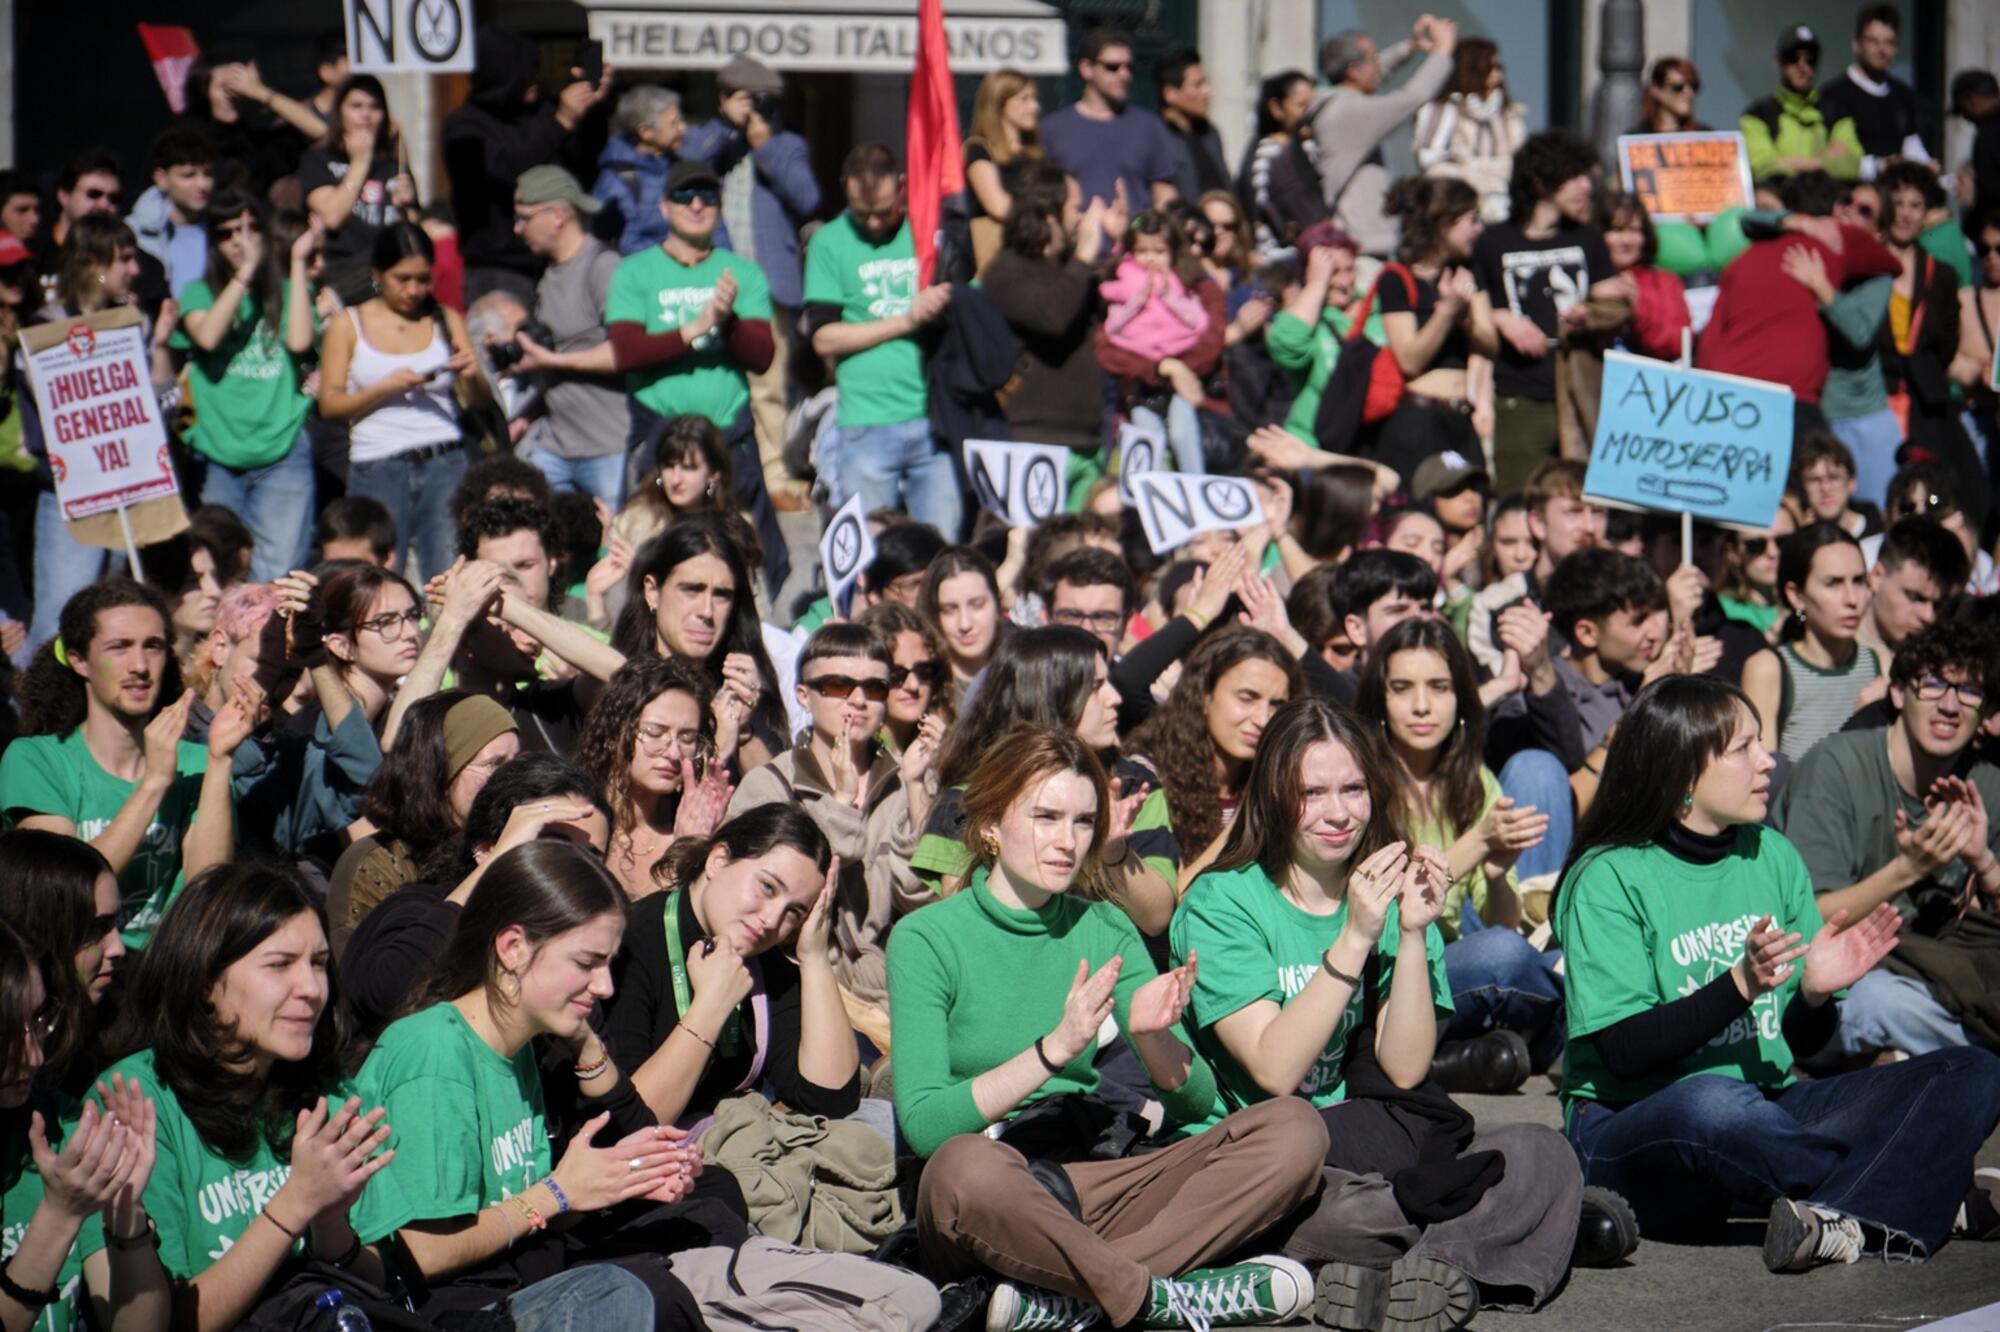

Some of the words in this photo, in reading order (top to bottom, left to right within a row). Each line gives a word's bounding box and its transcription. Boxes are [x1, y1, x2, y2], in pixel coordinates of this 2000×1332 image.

[352, 0, 462, 63] NO
[608, 22, 812, 56] HELADOS
[835, 23, 1046, 61] ITALNOS
[48, 359, 139, 410] ¡HUELGA
[1619, 369, 1760, 430] AYUSO
[54, 396, 151, 444] GENERAL
[92, 439, 131, 473] YA!
[1600, 430, 1773, 483] MOTOSIERRA
[970, 451, 1058, 526] NO
[1143, 477, 1253, 543] NO
